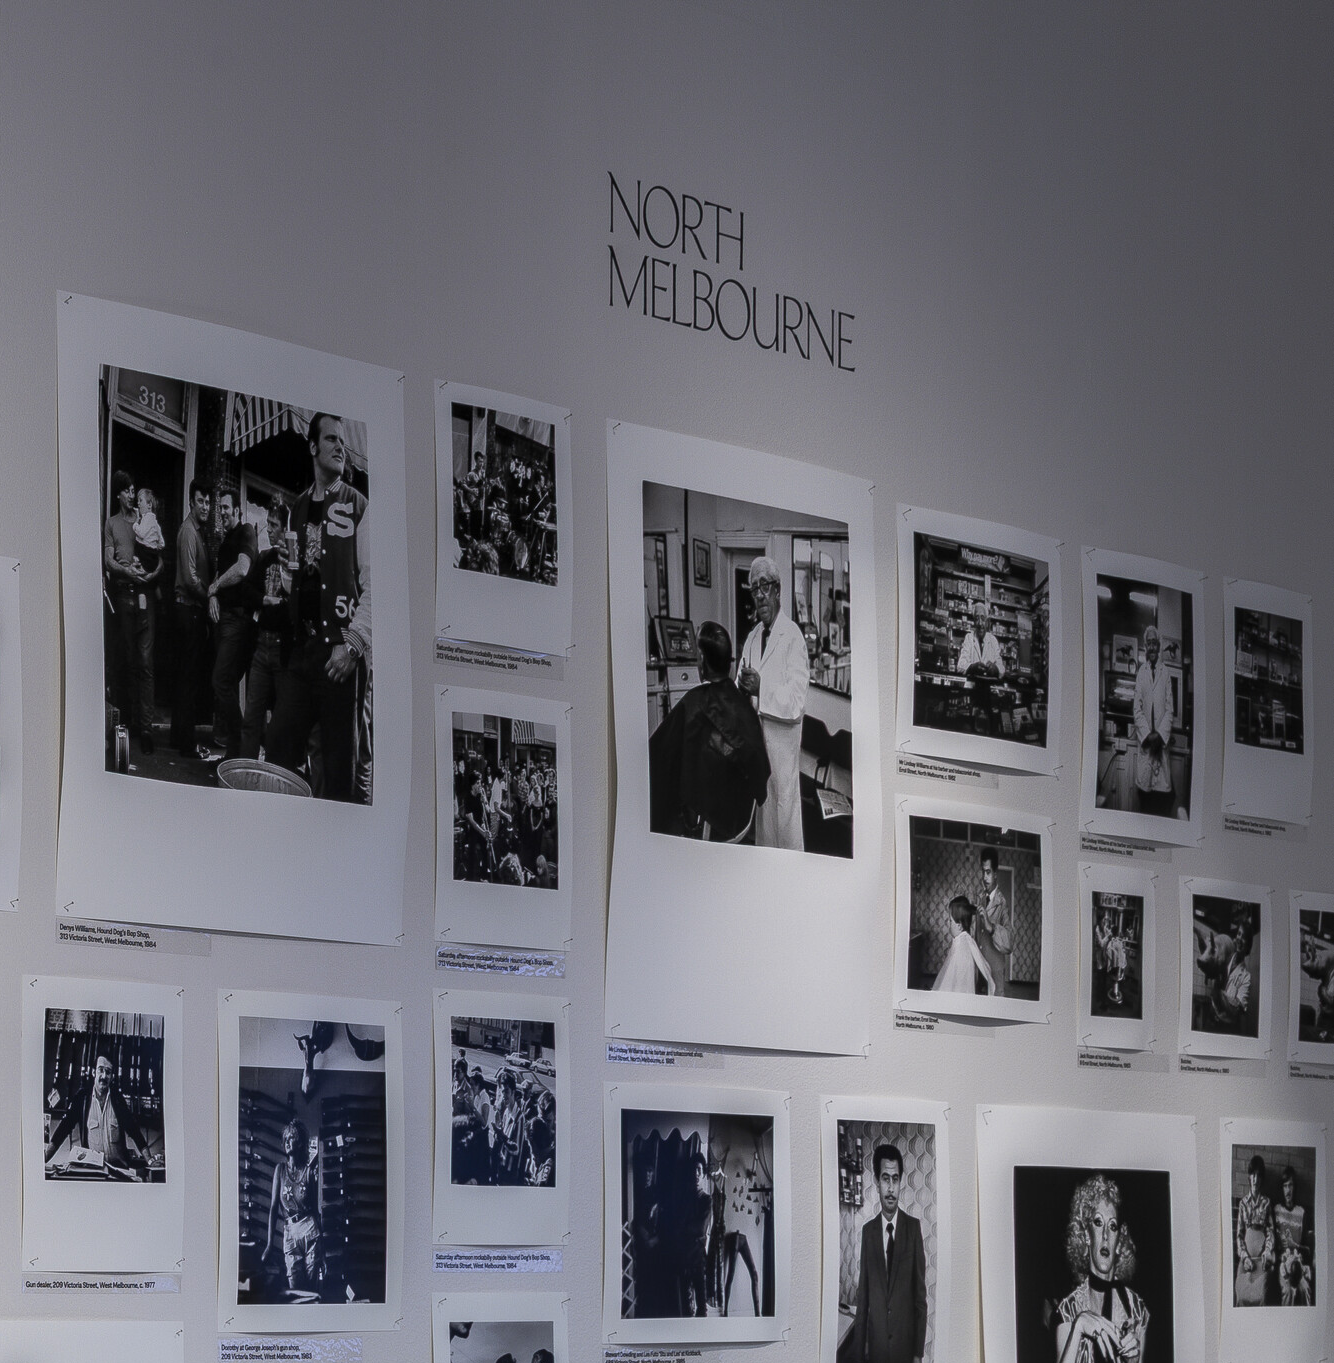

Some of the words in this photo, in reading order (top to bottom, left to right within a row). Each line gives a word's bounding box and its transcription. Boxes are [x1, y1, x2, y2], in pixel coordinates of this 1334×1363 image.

[607, 170, 744, 271] NORTH
[607, 244, 856, 373] MELBOURNE
[138, 385, 166, 414] 313
[326, 502, 355, 538] S
